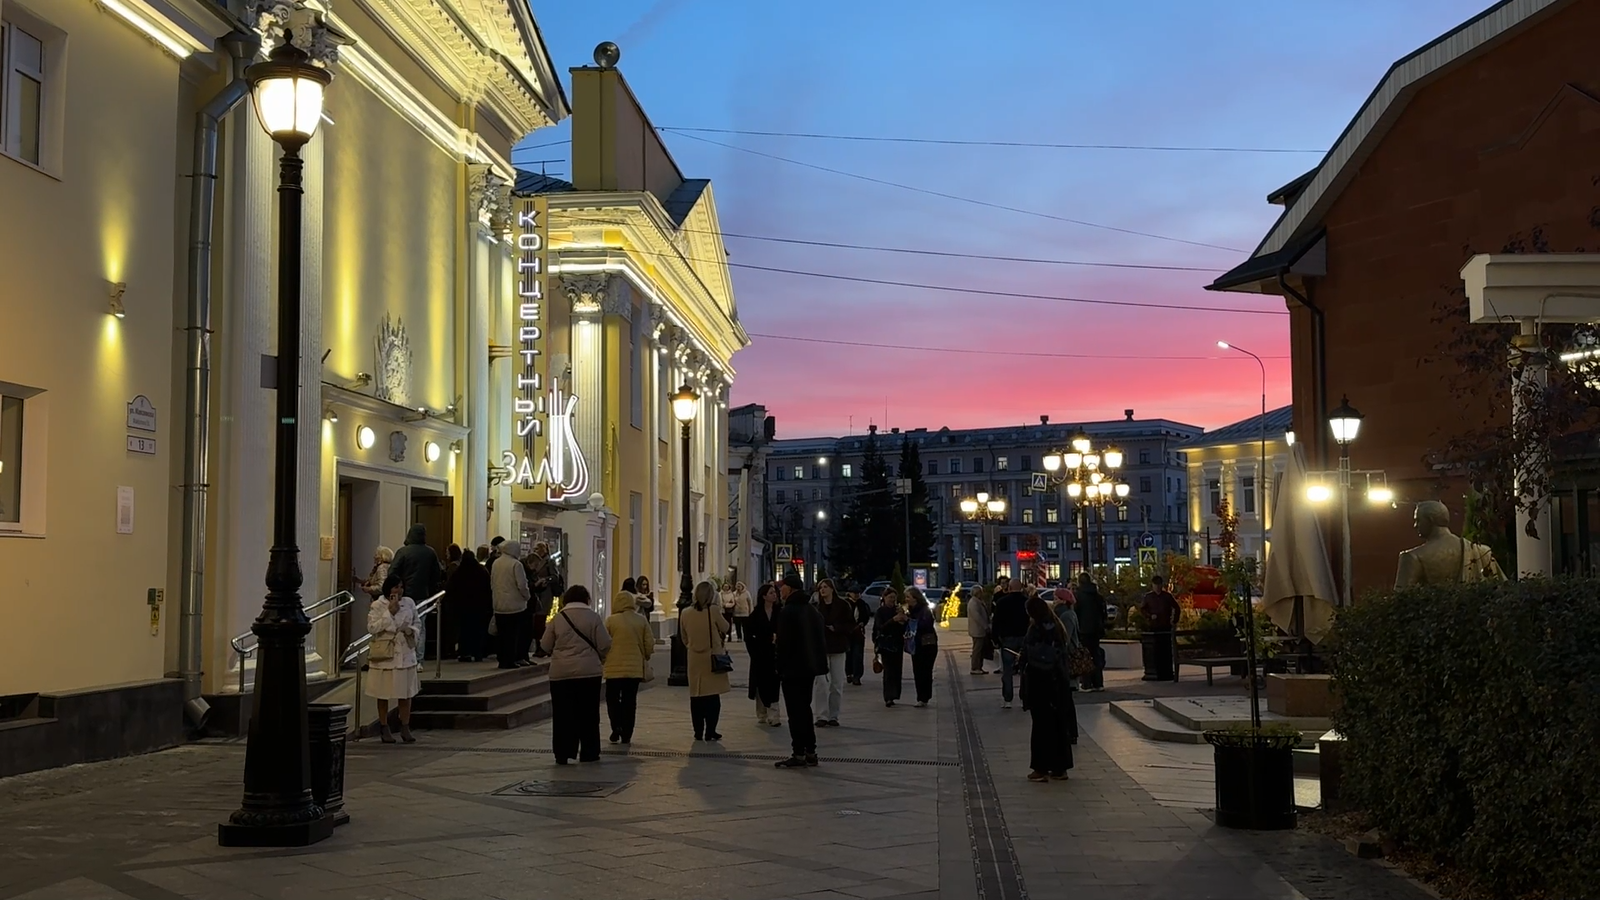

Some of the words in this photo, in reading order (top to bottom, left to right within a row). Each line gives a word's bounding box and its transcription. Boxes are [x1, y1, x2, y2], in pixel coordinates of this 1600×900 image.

[515, 210, 545, 436] КОНЦЕРТНЫЙ
[138, 439, 145, 451] 13
[502, 451, 553, 485] ЗАЛ
